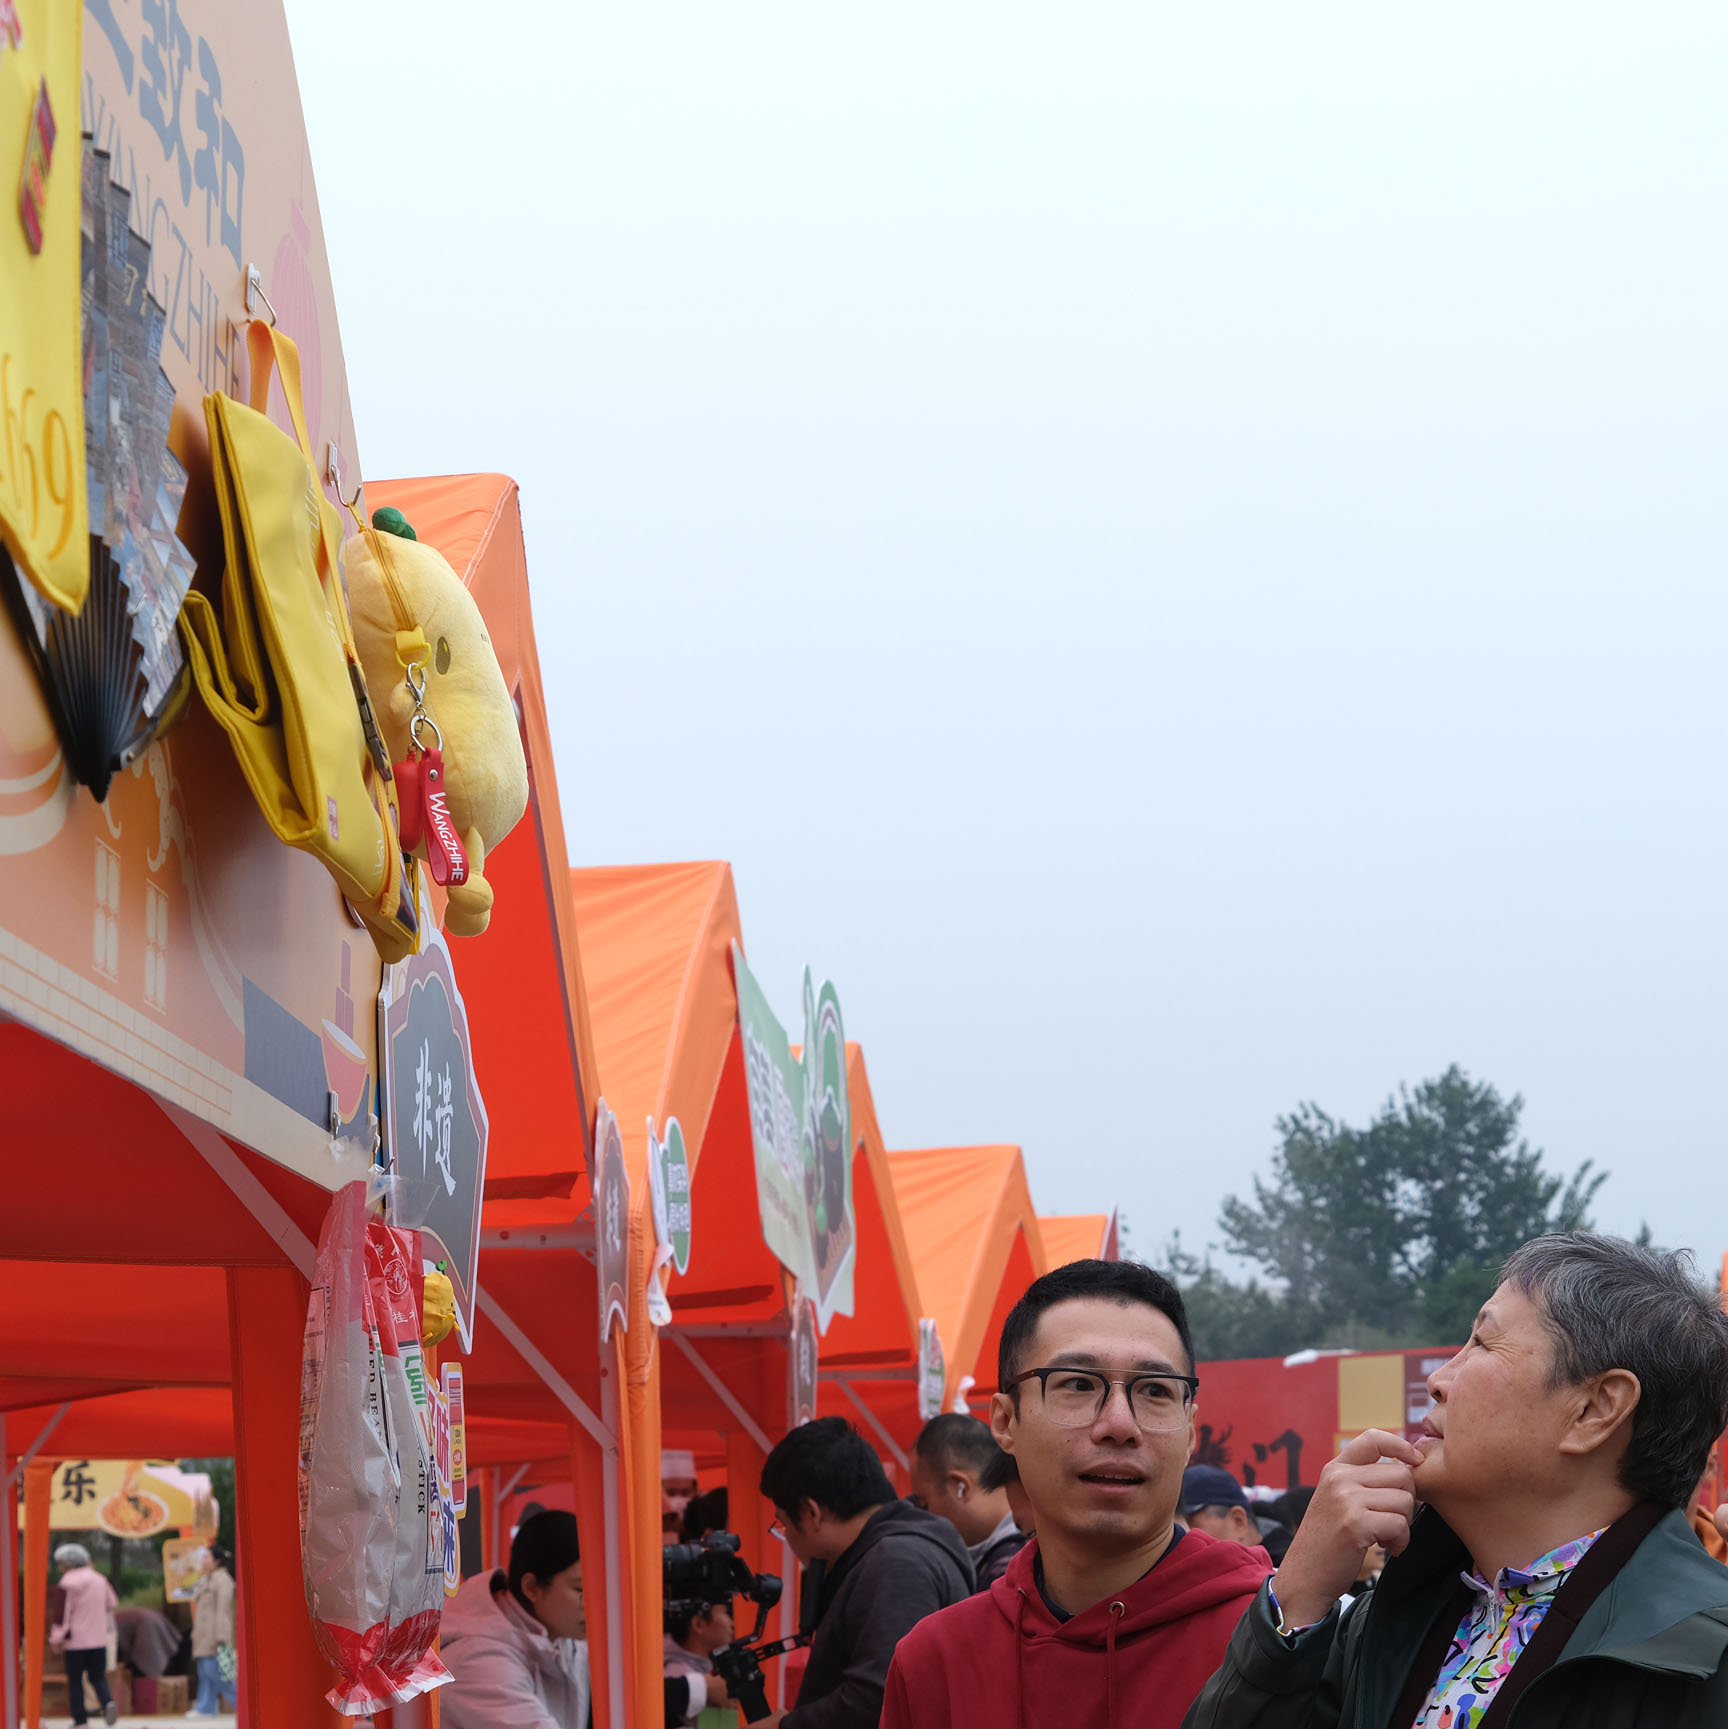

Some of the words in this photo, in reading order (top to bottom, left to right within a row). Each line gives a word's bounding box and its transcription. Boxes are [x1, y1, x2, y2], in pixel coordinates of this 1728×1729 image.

[84, 0, 246, 273] 致和
[429, 790, 465, 882] WANGZHIHE
[413, 1036, 457, 1197] 非遗
